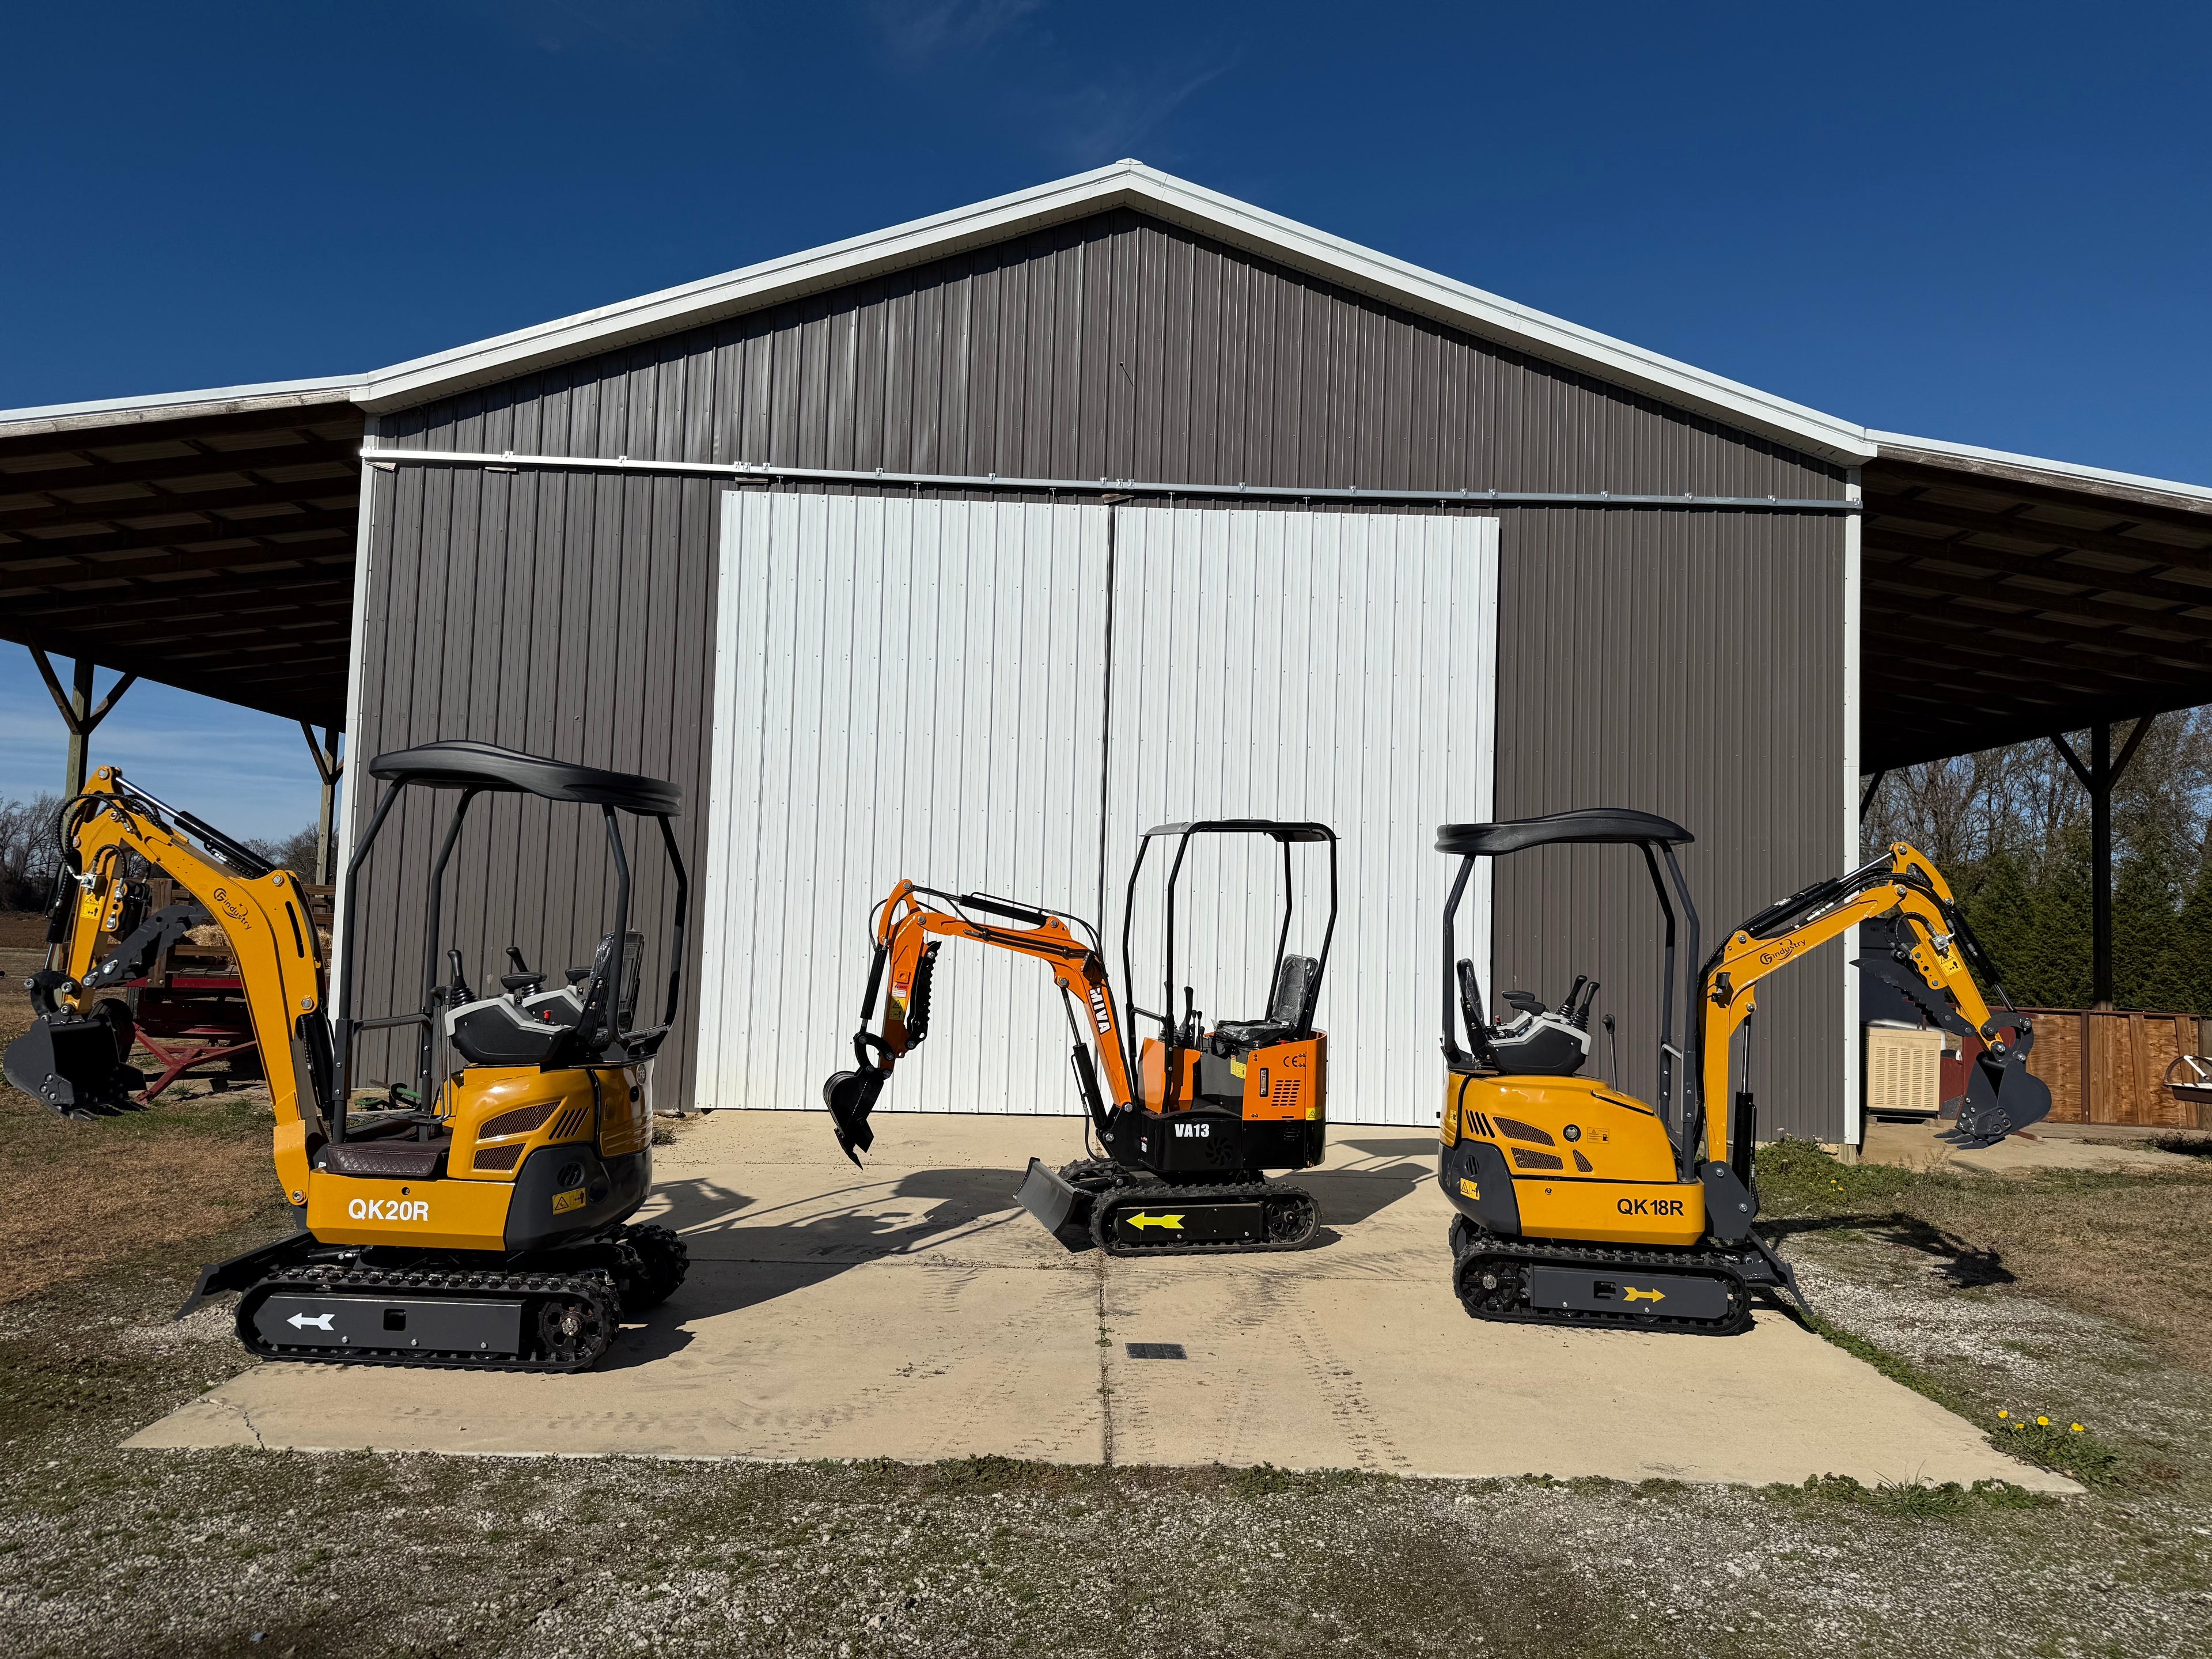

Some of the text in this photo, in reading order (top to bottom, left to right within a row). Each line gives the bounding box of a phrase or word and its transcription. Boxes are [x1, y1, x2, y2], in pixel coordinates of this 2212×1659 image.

[1089, 986, 1111, 1034] MIVA
[1283, 1056, 1298, 1067] CE
[1175, 1123, 1210, 1138] VA13
[349, 1198, 429, 1221] QK20R
[1617, 1198, 1684, 1216] QK18R
